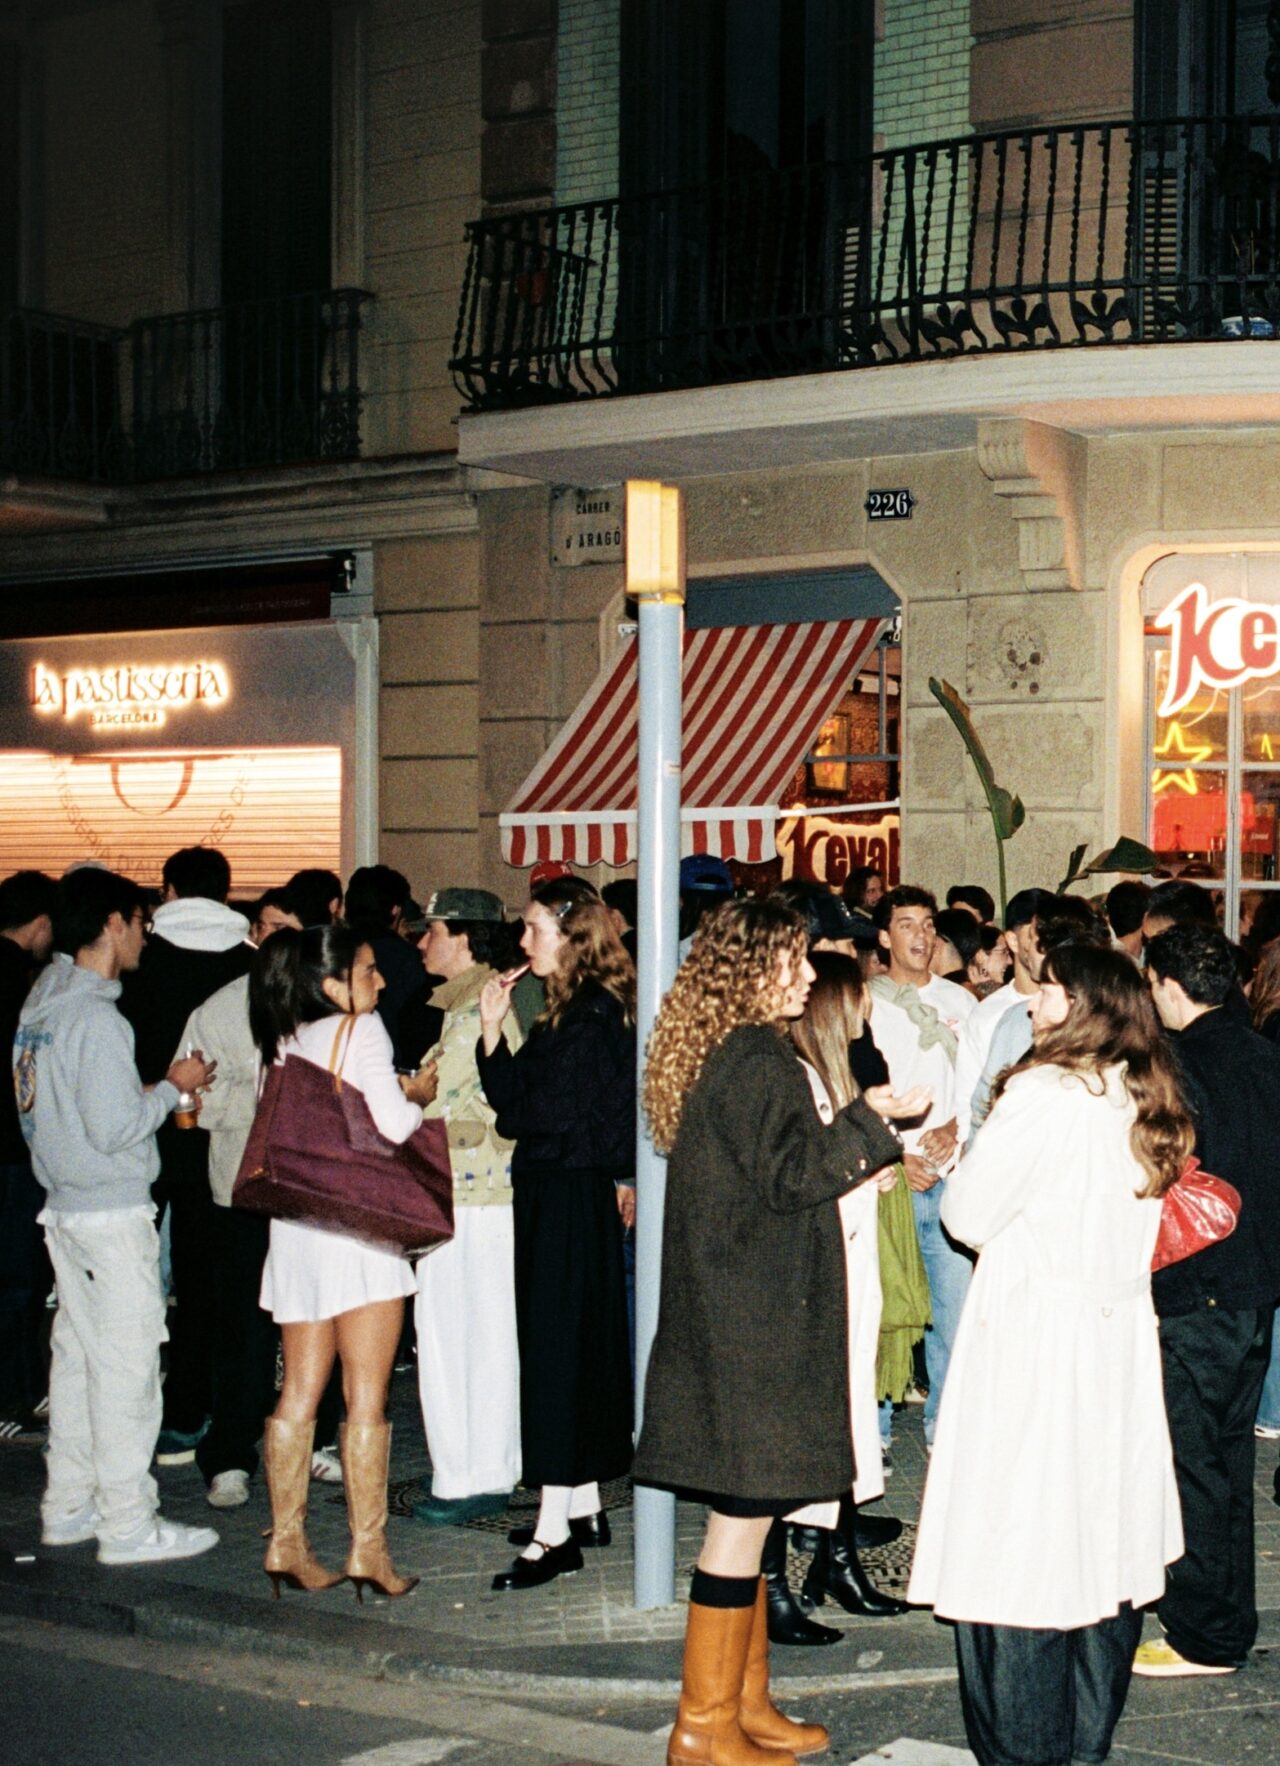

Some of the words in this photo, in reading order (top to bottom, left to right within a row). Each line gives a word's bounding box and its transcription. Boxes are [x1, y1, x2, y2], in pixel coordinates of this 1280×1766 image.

[576, 501, 610, 515] CARRER
[869, 491, 908, 517] 226
[30, 664, 57, 706] la
[61, 663, 223, 716] pastisseria
[88, 712, 158, 726] BARCELONA
